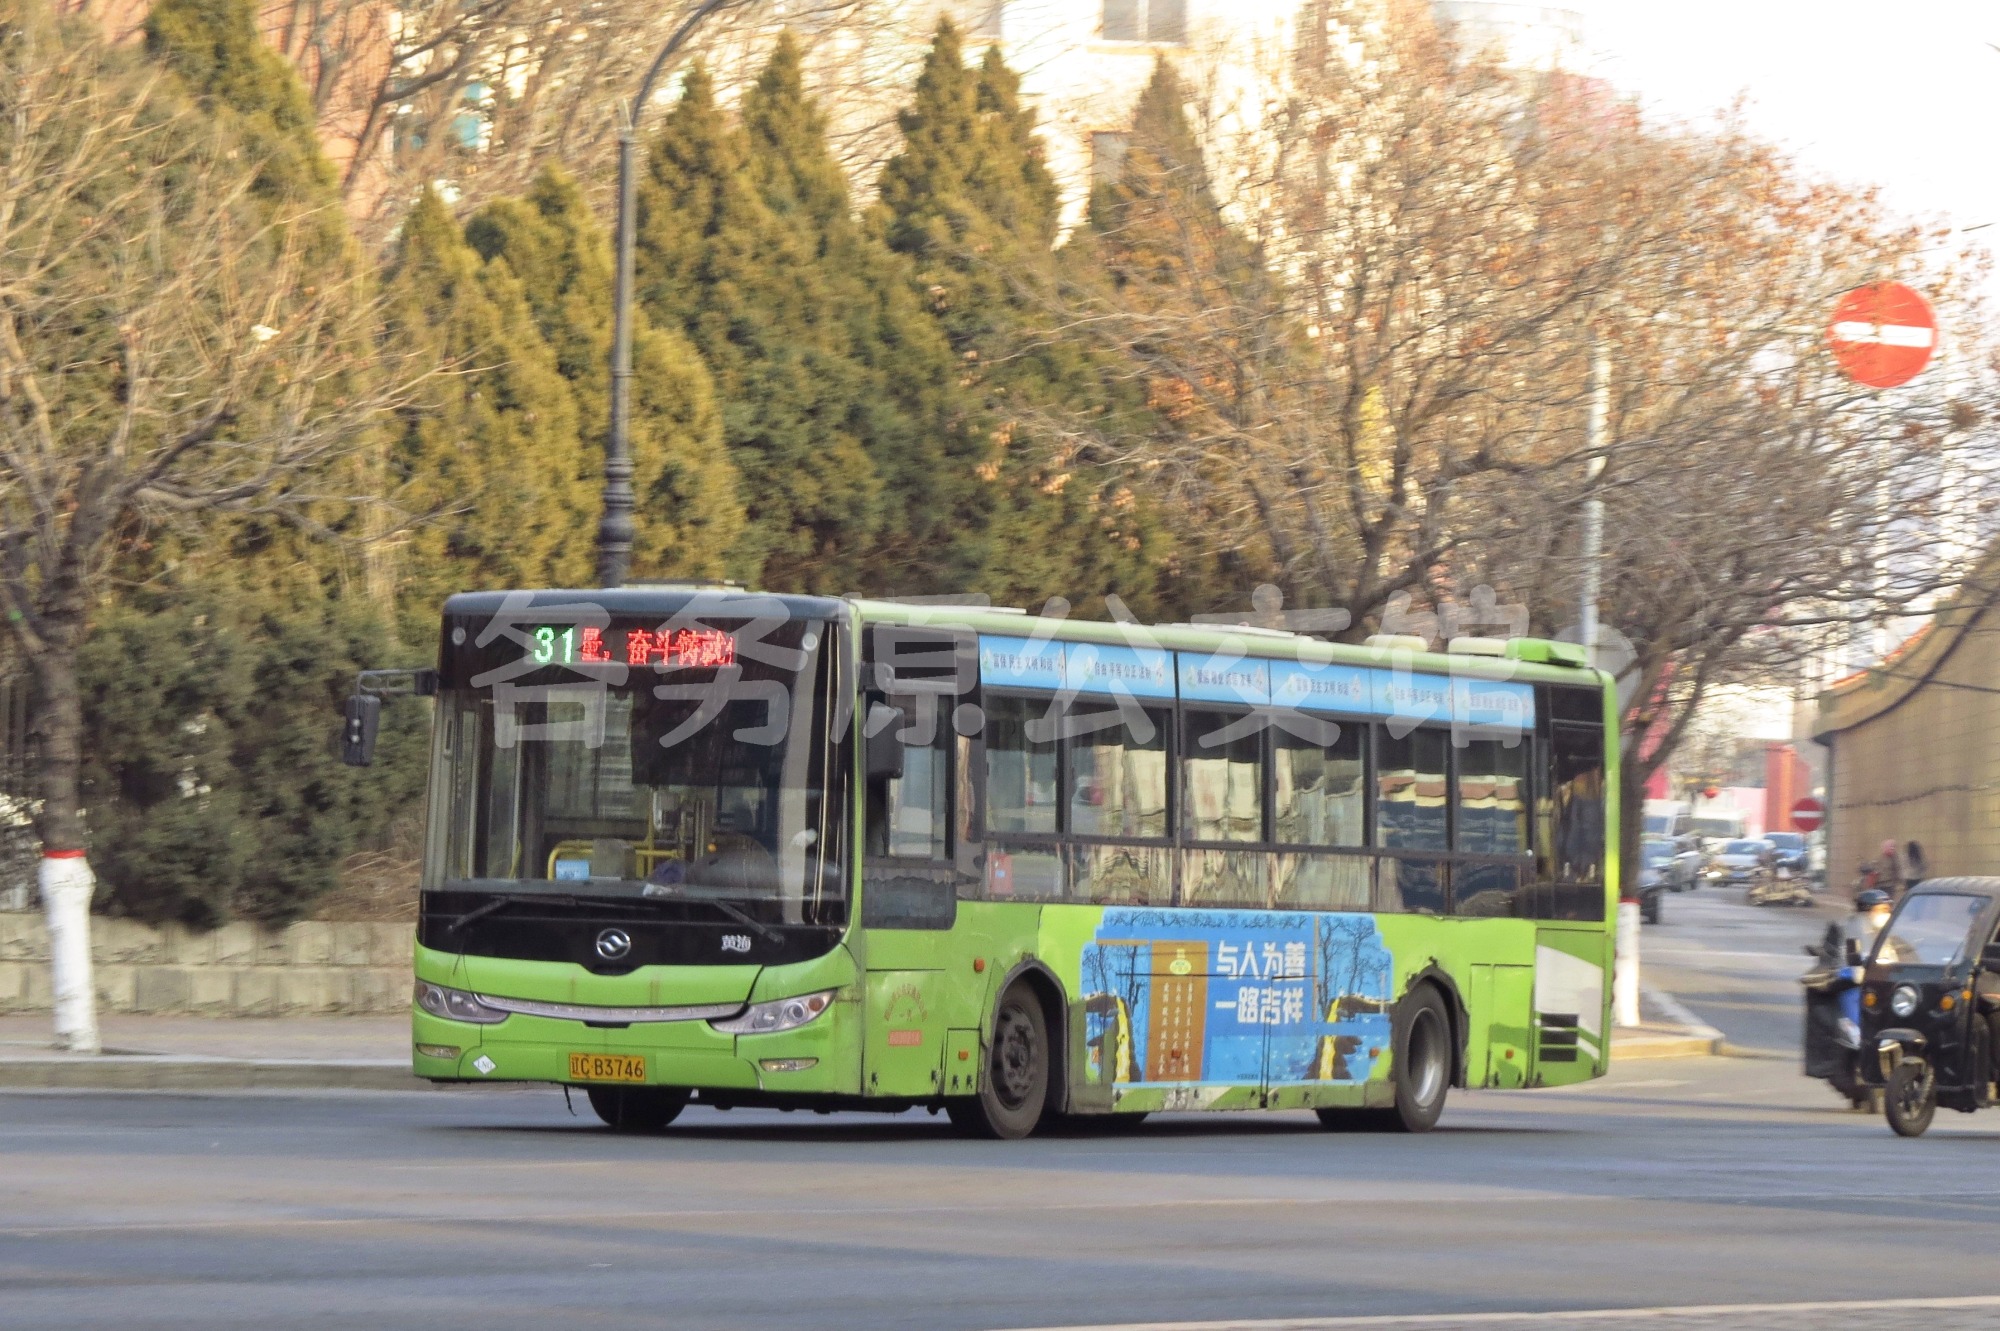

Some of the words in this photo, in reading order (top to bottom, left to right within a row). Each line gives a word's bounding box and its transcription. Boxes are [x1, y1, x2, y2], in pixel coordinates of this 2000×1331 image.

[534, 626, 575, 665] 31
[720, 934, 752, 952] 黄海
[1216, 940, 1306, 982] 与人为善
[1215, 986, 1304, 1025] 一路吉祥
